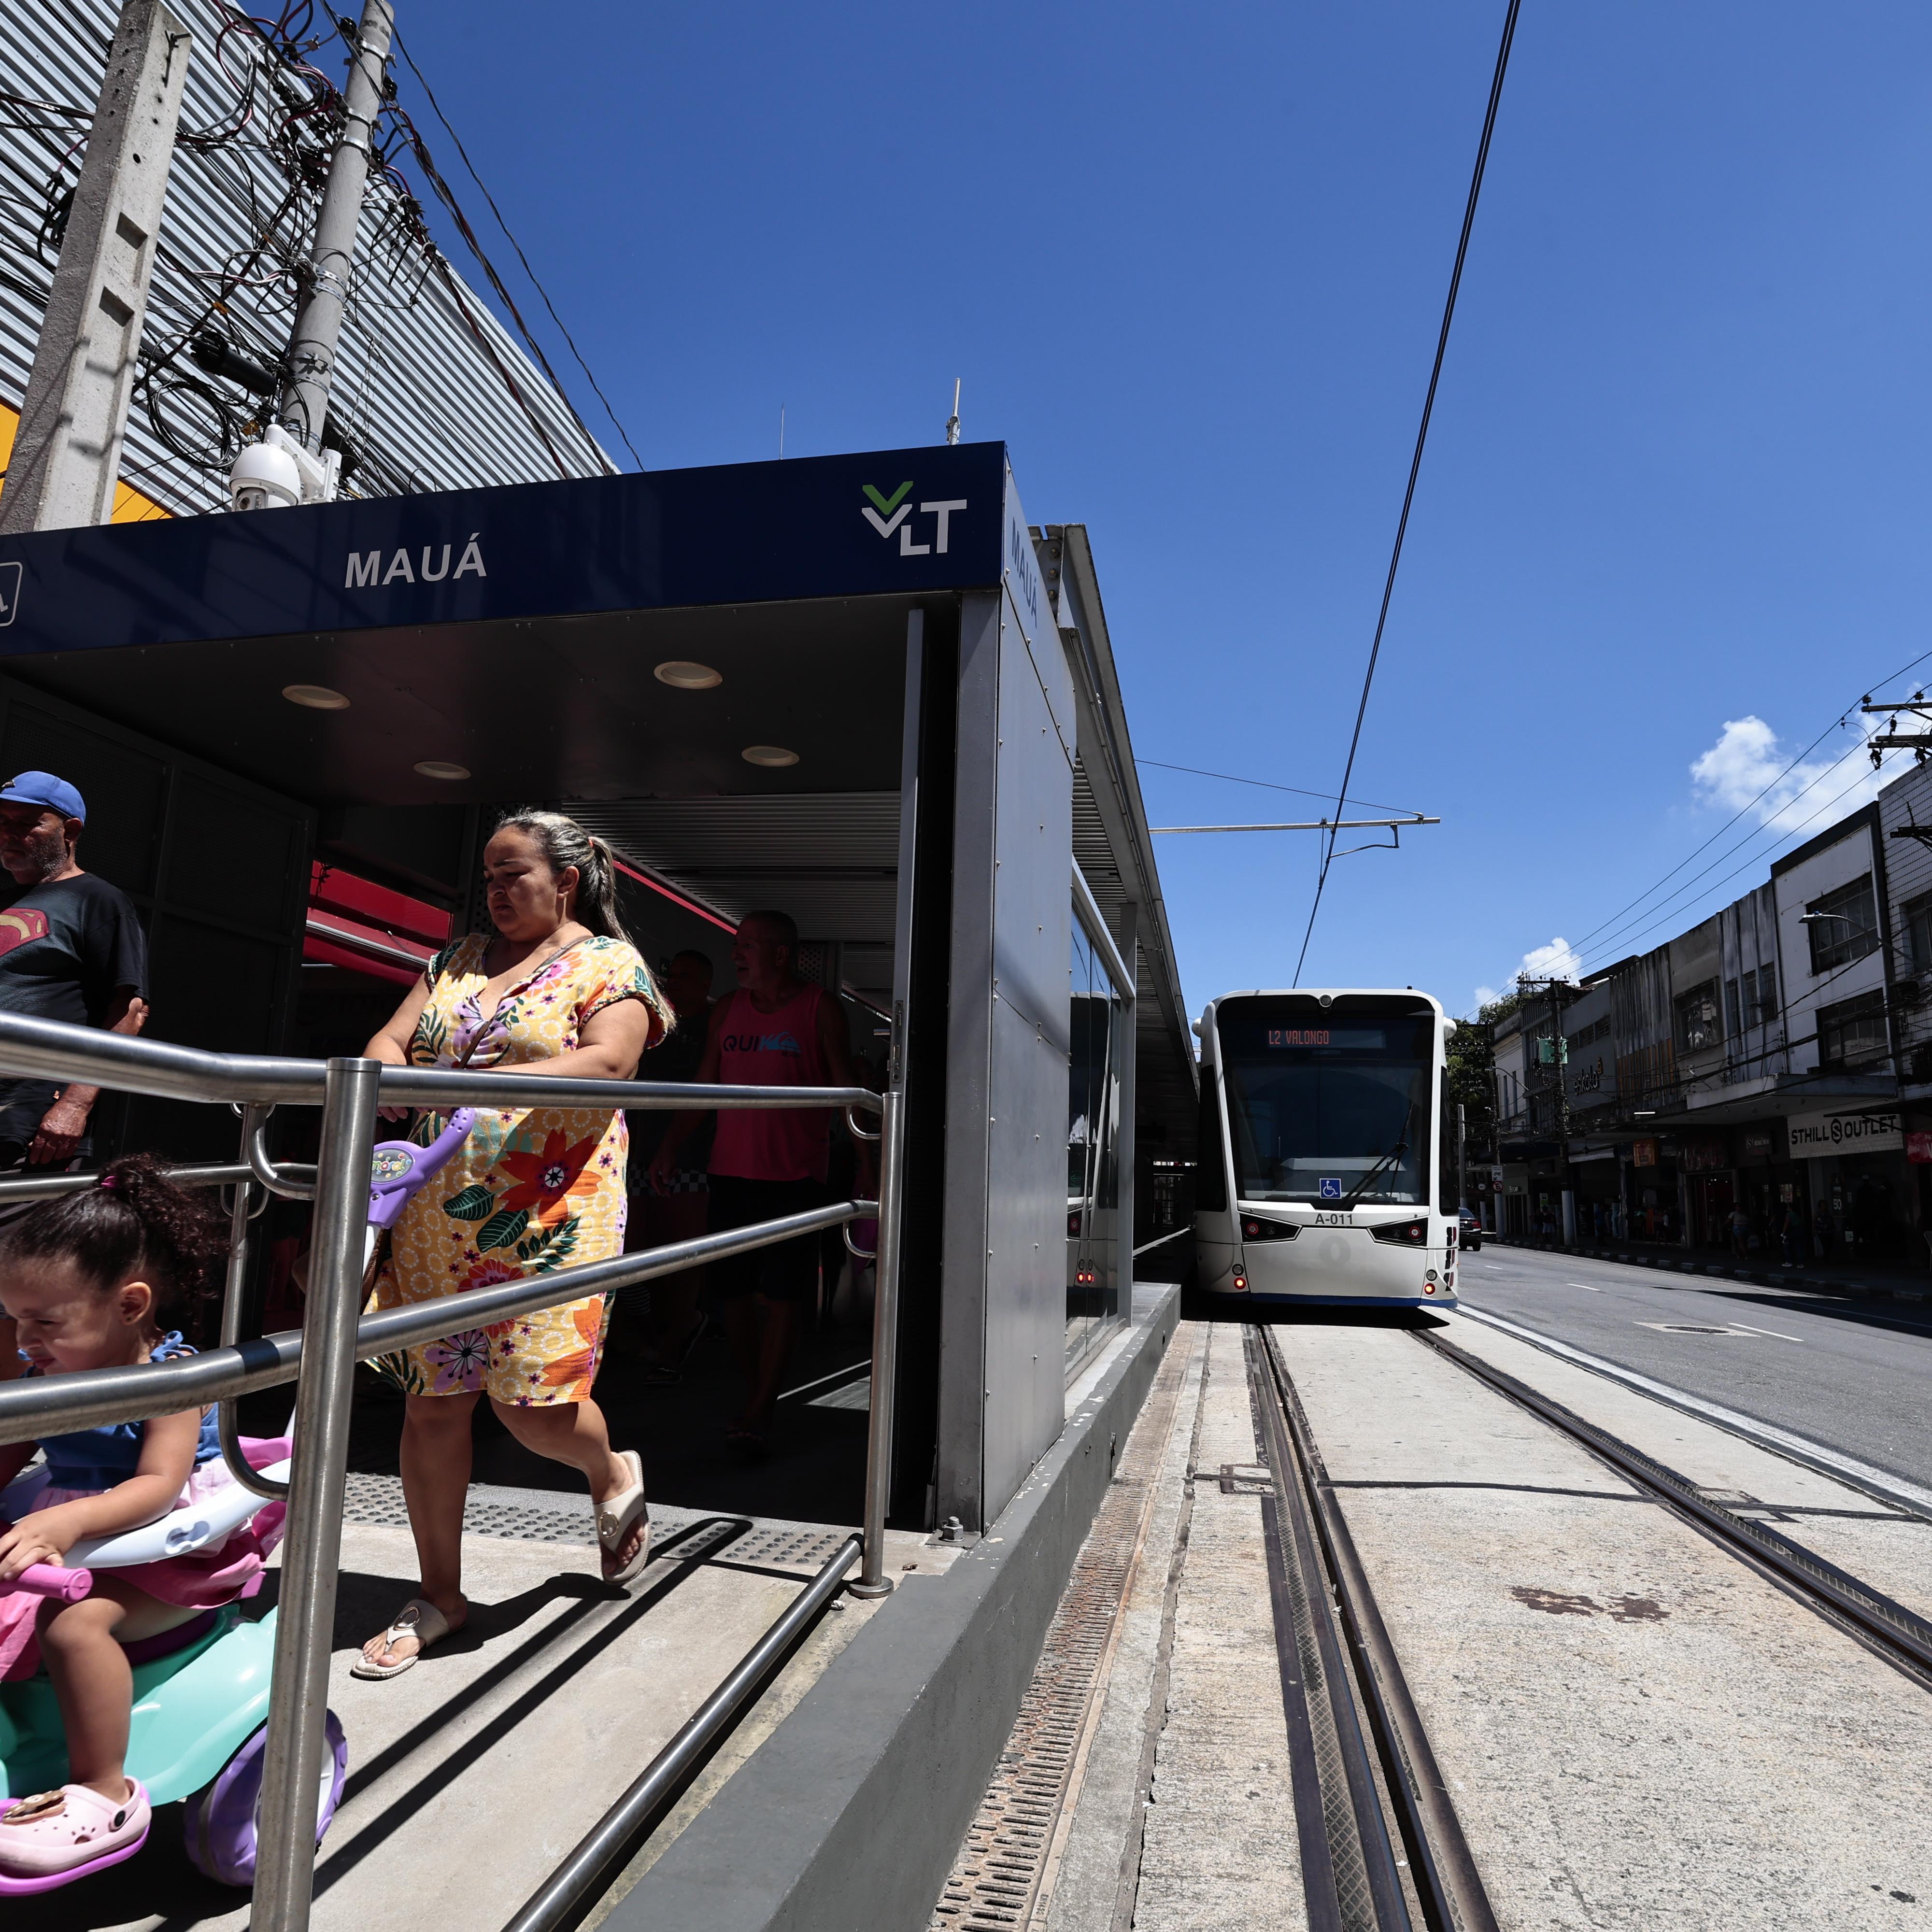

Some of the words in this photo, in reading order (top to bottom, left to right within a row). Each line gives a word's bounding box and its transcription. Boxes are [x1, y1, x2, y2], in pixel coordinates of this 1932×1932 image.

[862, 499, 967, 556] VLT
[345, 532, 487, 588] MAUÁ
[1012, 517, 1037, 628] MAUÁ
[1269, 1030, 1280, 1044] L2
[1286, 1030, 1329, 1045] VALONGO
[1792, 1125, 1829, 1145] STHILL
[1845, 1115, 1896, 1138] OUTLET
[1315, 1213, 1352, 1224] A-011
